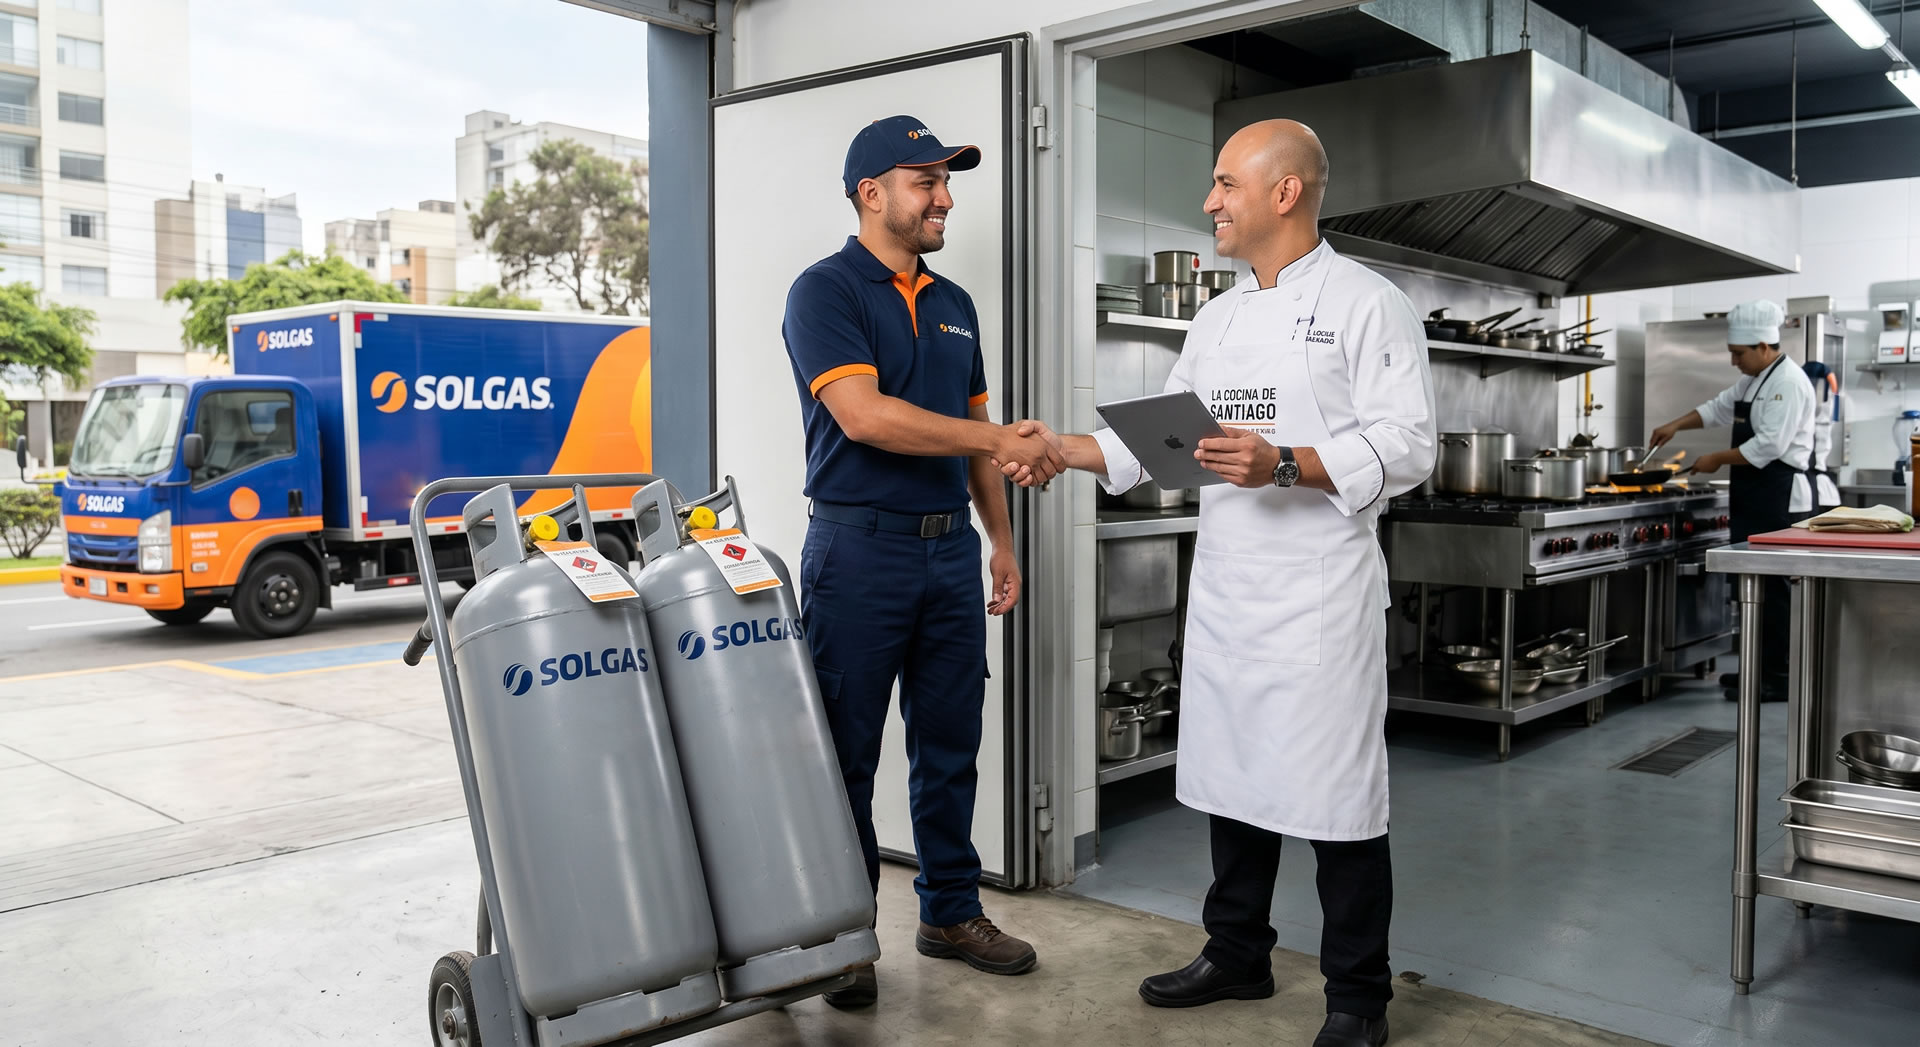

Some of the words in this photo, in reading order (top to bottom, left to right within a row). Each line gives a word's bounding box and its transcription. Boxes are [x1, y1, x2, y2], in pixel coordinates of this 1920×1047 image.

[268, 327, 313, 350] SOLGAS
[947, 325, 973, 339] SOLGAS
[1211, 389, 1222, 401] LA
[1223, 388, 1259, 401] COCINA
[1262, 387, 1277, 400] DE
[1210, 403, 1276, 421] SANTIAGO
[86, 495, 125, 513] SOLGAS
[712, 617, 803, 651] SOLGAS
[540, 648, 649, 686] SOLGAS
